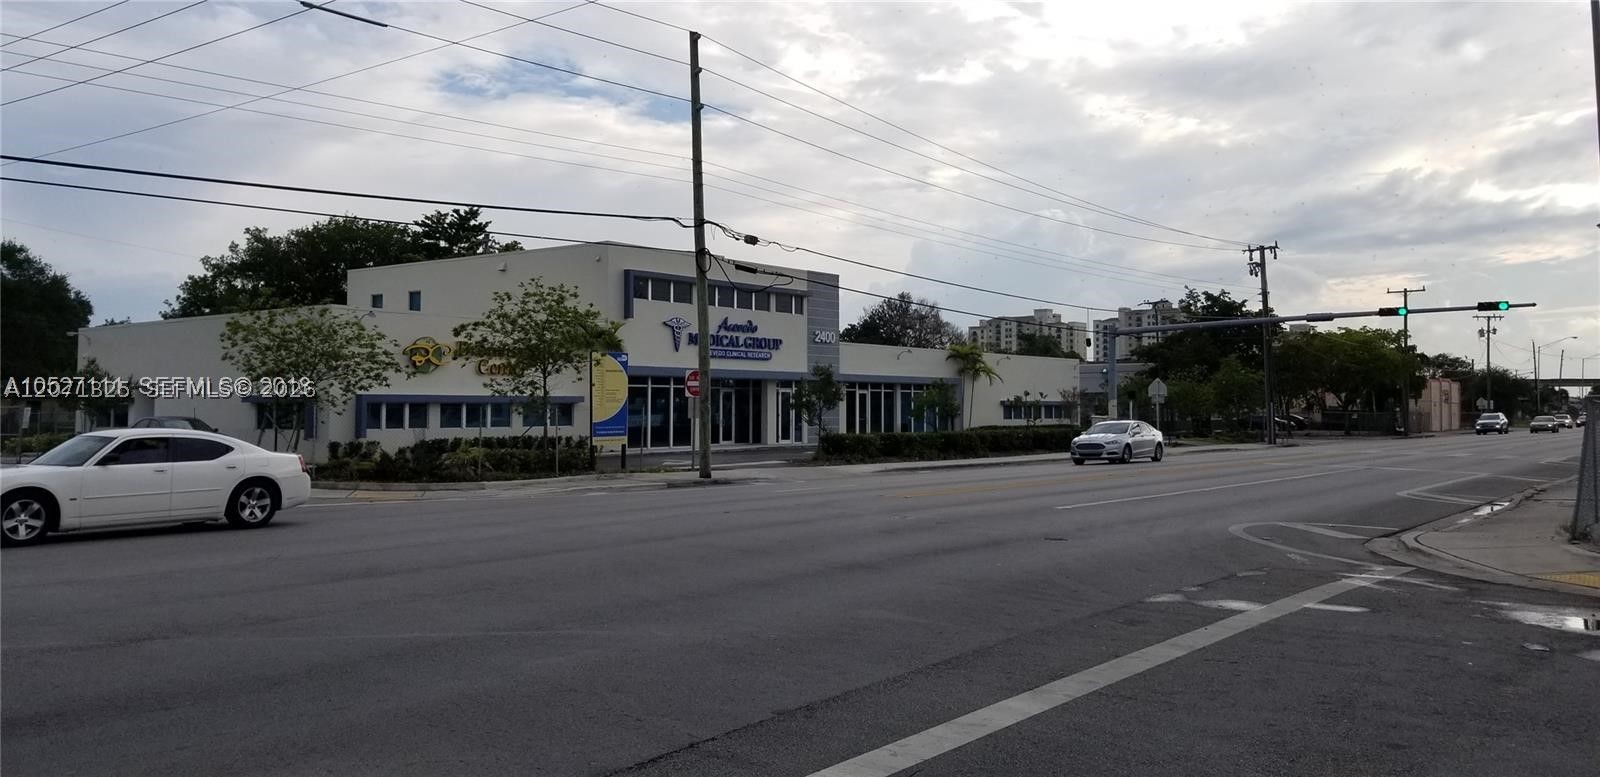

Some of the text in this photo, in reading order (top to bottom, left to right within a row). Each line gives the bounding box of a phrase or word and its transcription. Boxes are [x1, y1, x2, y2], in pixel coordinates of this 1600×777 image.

[716, 316, 758, 333] Acevedo
[687, 332, 783, 351] MDICAL GROUP
[814, 330, 836, 344] 2400
[726, 350, 747, 358] CLINICAL
[747, 351, 771, 359] RESEARCH
